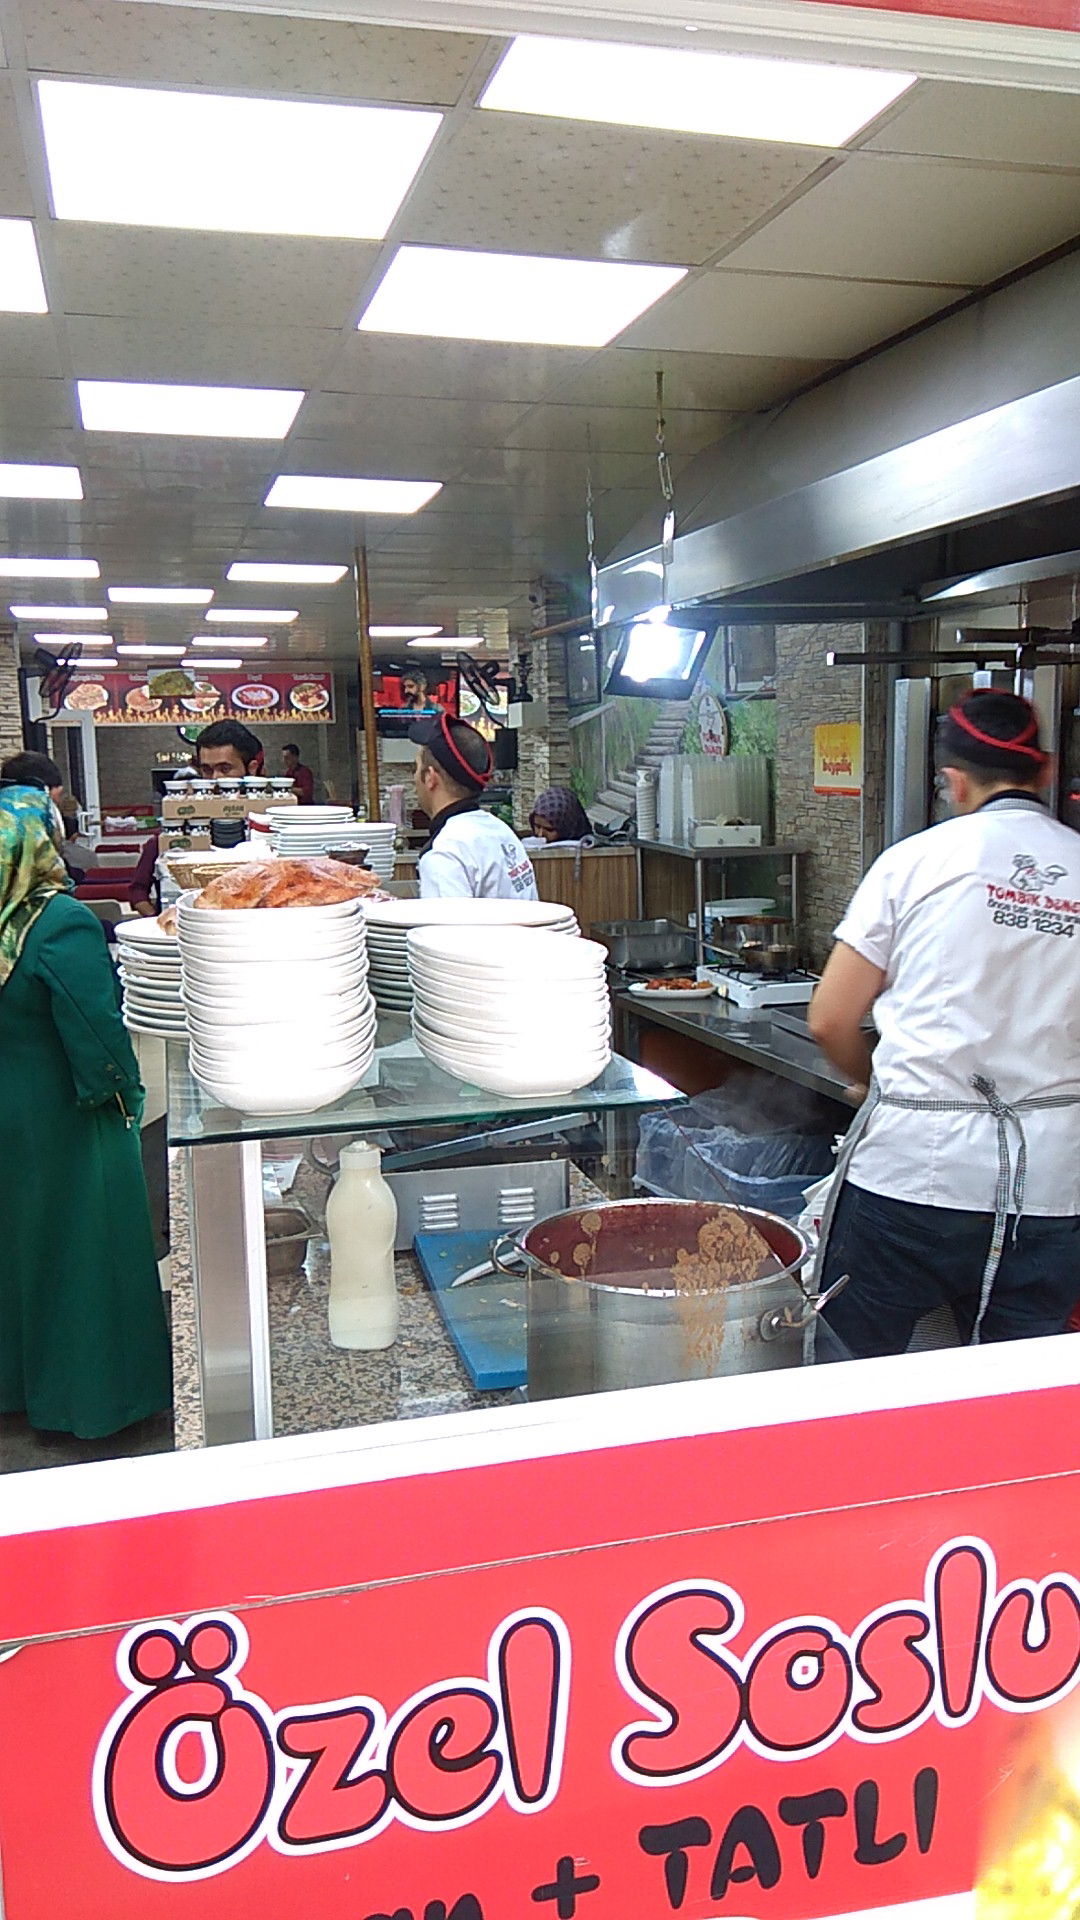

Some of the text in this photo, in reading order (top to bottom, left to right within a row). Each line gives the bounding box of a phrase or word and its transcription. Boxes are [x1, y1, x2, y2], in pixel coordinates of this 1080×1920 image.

[993, 910, 1074, 938] 838 1234
[94, 1535, 1080, 1880] Özel Soslu
[640, 1767, 938, 1909] TATLI
